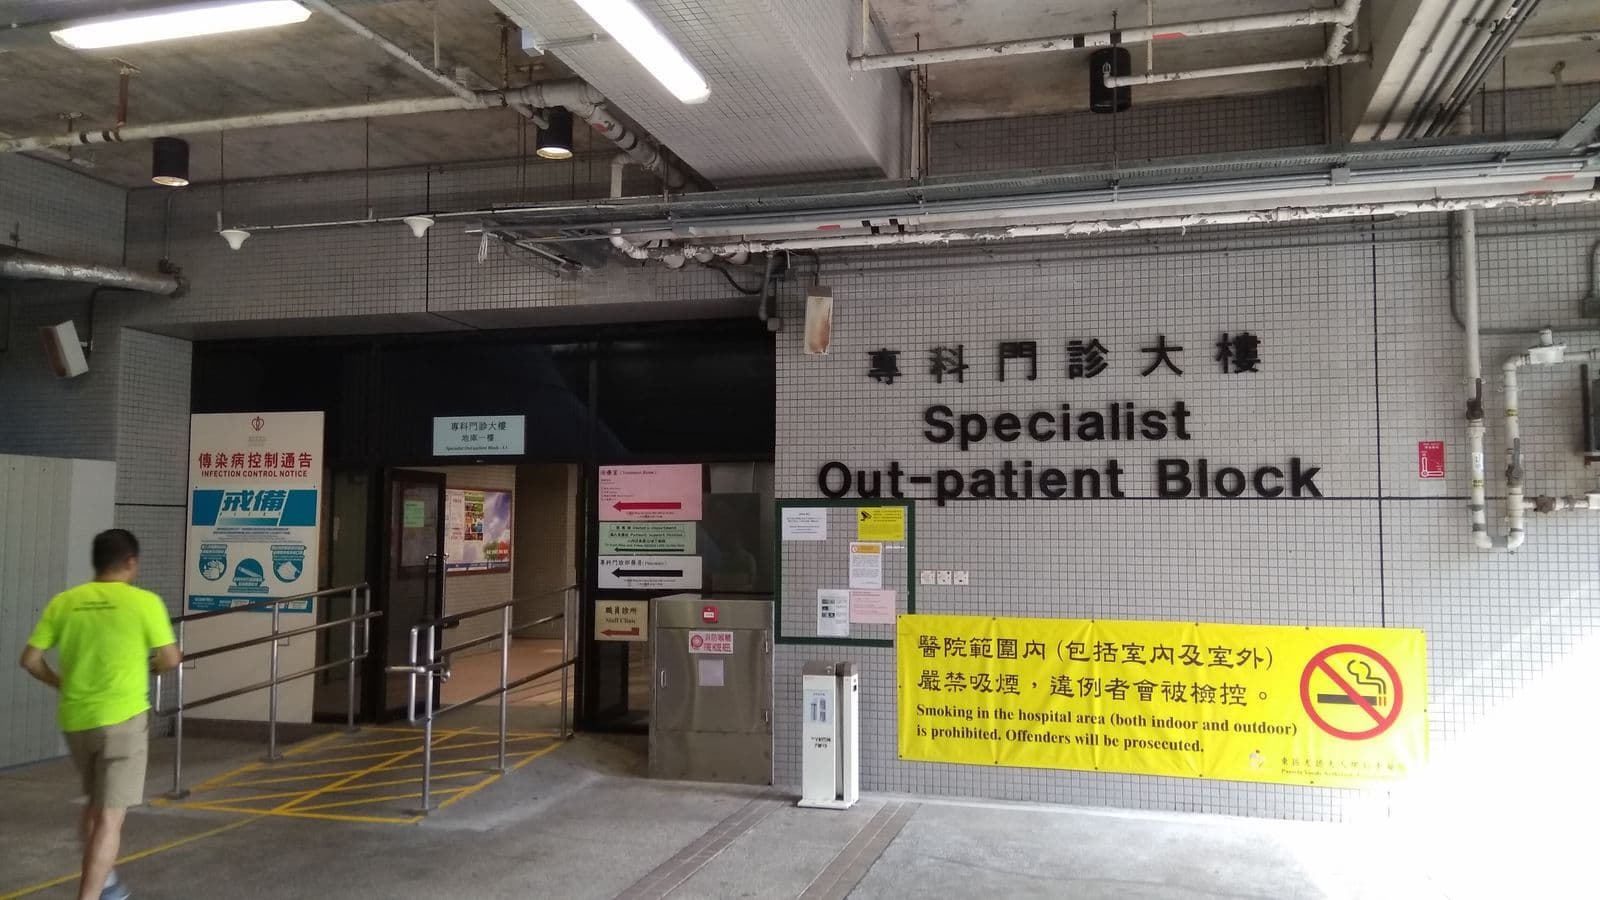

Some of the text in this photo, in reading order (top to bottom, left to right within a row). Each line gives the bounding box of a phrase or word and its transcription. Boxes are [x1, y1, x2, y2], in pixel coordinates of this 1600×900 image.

[867, 332, 1263, 385] 專科門診大樓
[924, 401, 1191, 450] Specialist
[198, 452, 313, 469] 傳染病控制通告
[818, 457, 1324, 506] Out-patient Block
[916, 704, 1297, 736] Smoking in the hospital area (both indoor and outdoor)
[917, 725, 1204, 752] is prohibited. Offenders will be prosecuted.
